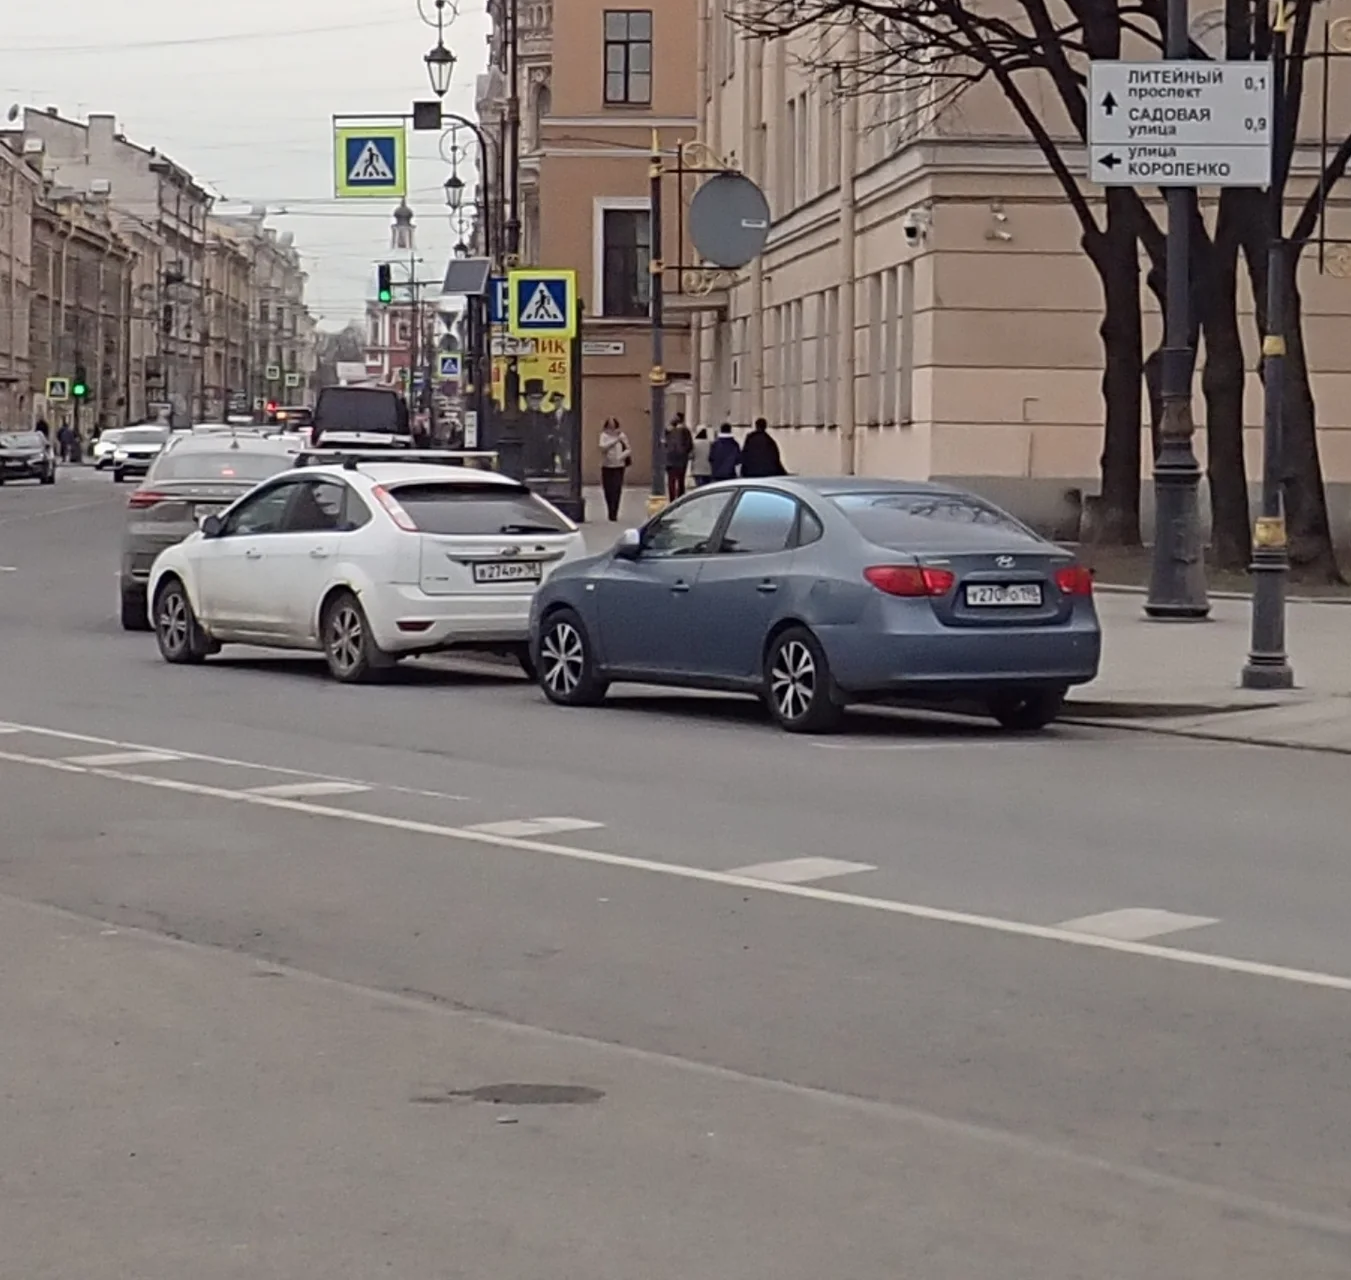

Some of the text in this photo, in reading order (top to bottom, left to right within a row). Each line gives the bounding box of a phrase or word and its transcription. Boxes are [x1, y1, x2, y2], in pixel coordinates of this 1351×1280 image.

[1128, 68, 1223, 84] ЛИТЕЙНЫЙ
[1244, 77, 1266, 92] 0,1
[1128, 86, 1202, 100] проспект
[1128, 107, 1211, 122] САДОВАЯ
[1128, 125, 1177, 138] улица
[1244, 117, 1267, 133] 0,9
[1128, 147, 1177, 160] улица
[1128, 162, 1231, 176] КОРОЛЕНКО
